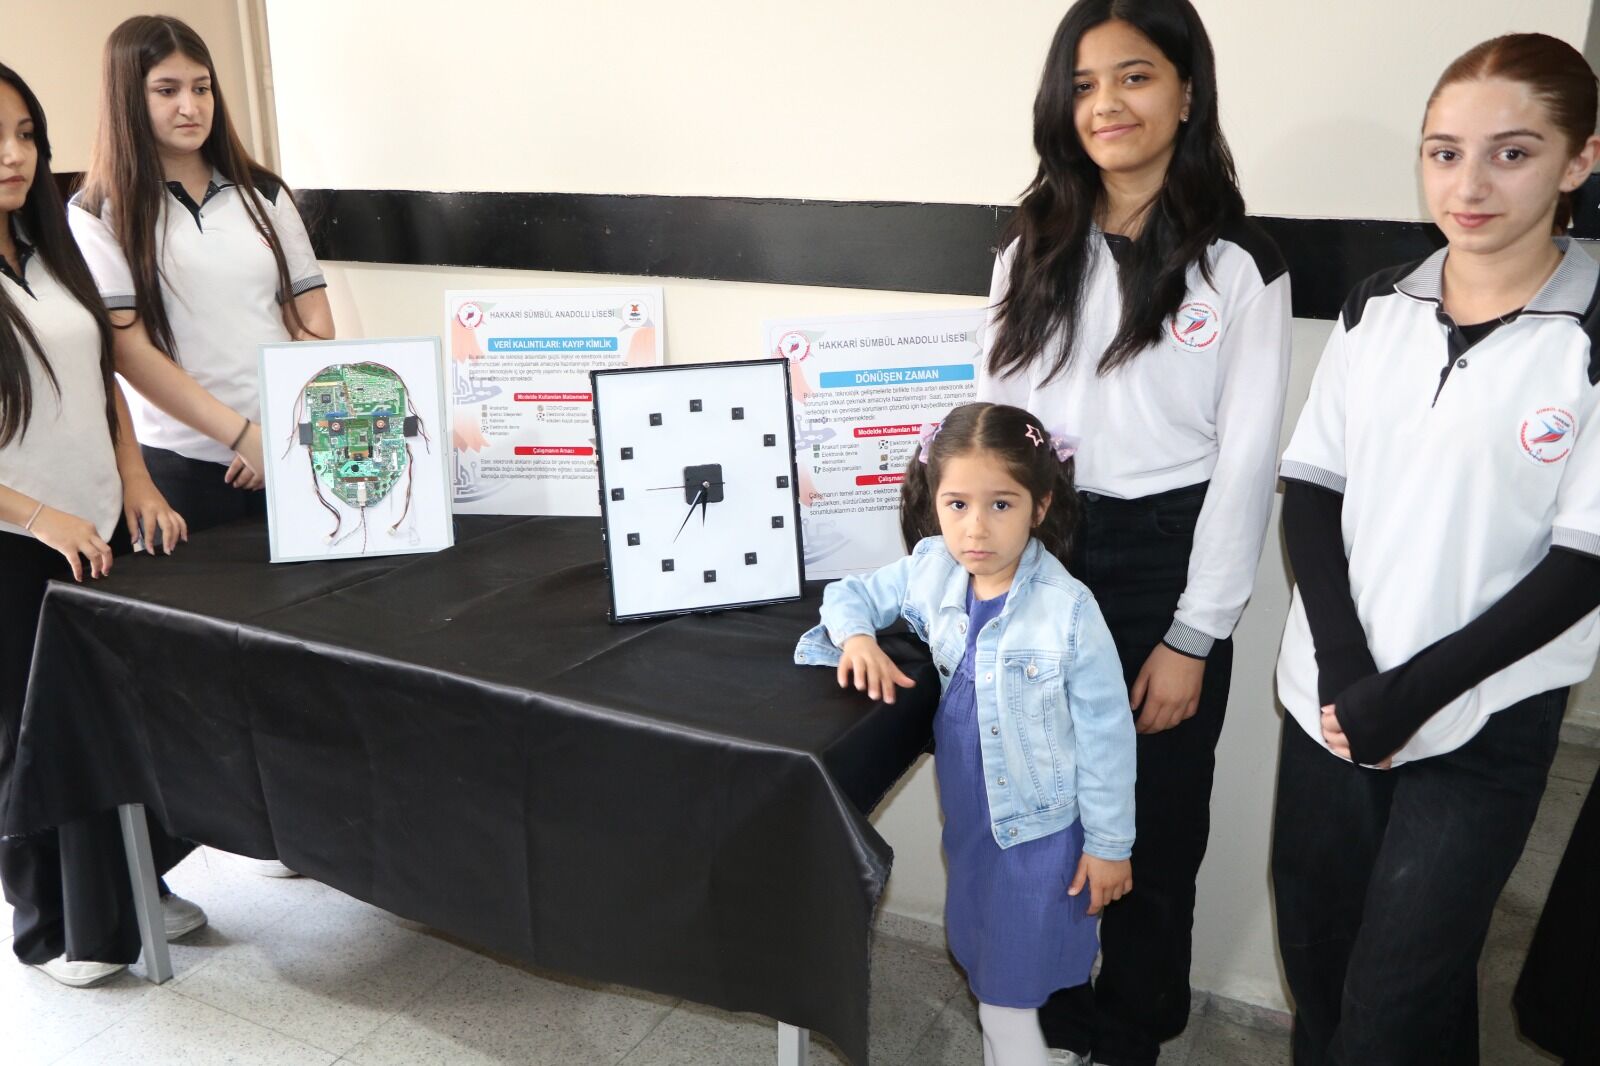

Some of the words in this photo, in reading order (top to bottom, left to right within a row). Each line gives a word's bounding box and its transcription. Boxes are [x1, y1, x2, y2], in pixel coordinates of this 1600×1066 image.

[490, 311, 522, 319] HAKKARİ
[523, 309, 553, 318] SÜMBÜL
[555, 310, 590, 318] ANADOLU
[592, 308, 615, 318] LİSESİ
[494, 340, 512, 349] VERİ
[513, 340, 561, 349] KALINTILARI:
[562, 340, 584, 349] KAYIP
[586, 338, 612, 348] KİMLİK
[819, 339, 857, 350] HAKKARİ
[860, 336, 895, 348] SÜMBÜL
[897, 335, 939, 345] ANADOLU
[941, 331, 967, 343] LİSESİ
[856, 371, 902, 383] DÖNÜŞEN
[904, 369, 939, 380] ZAMAN
